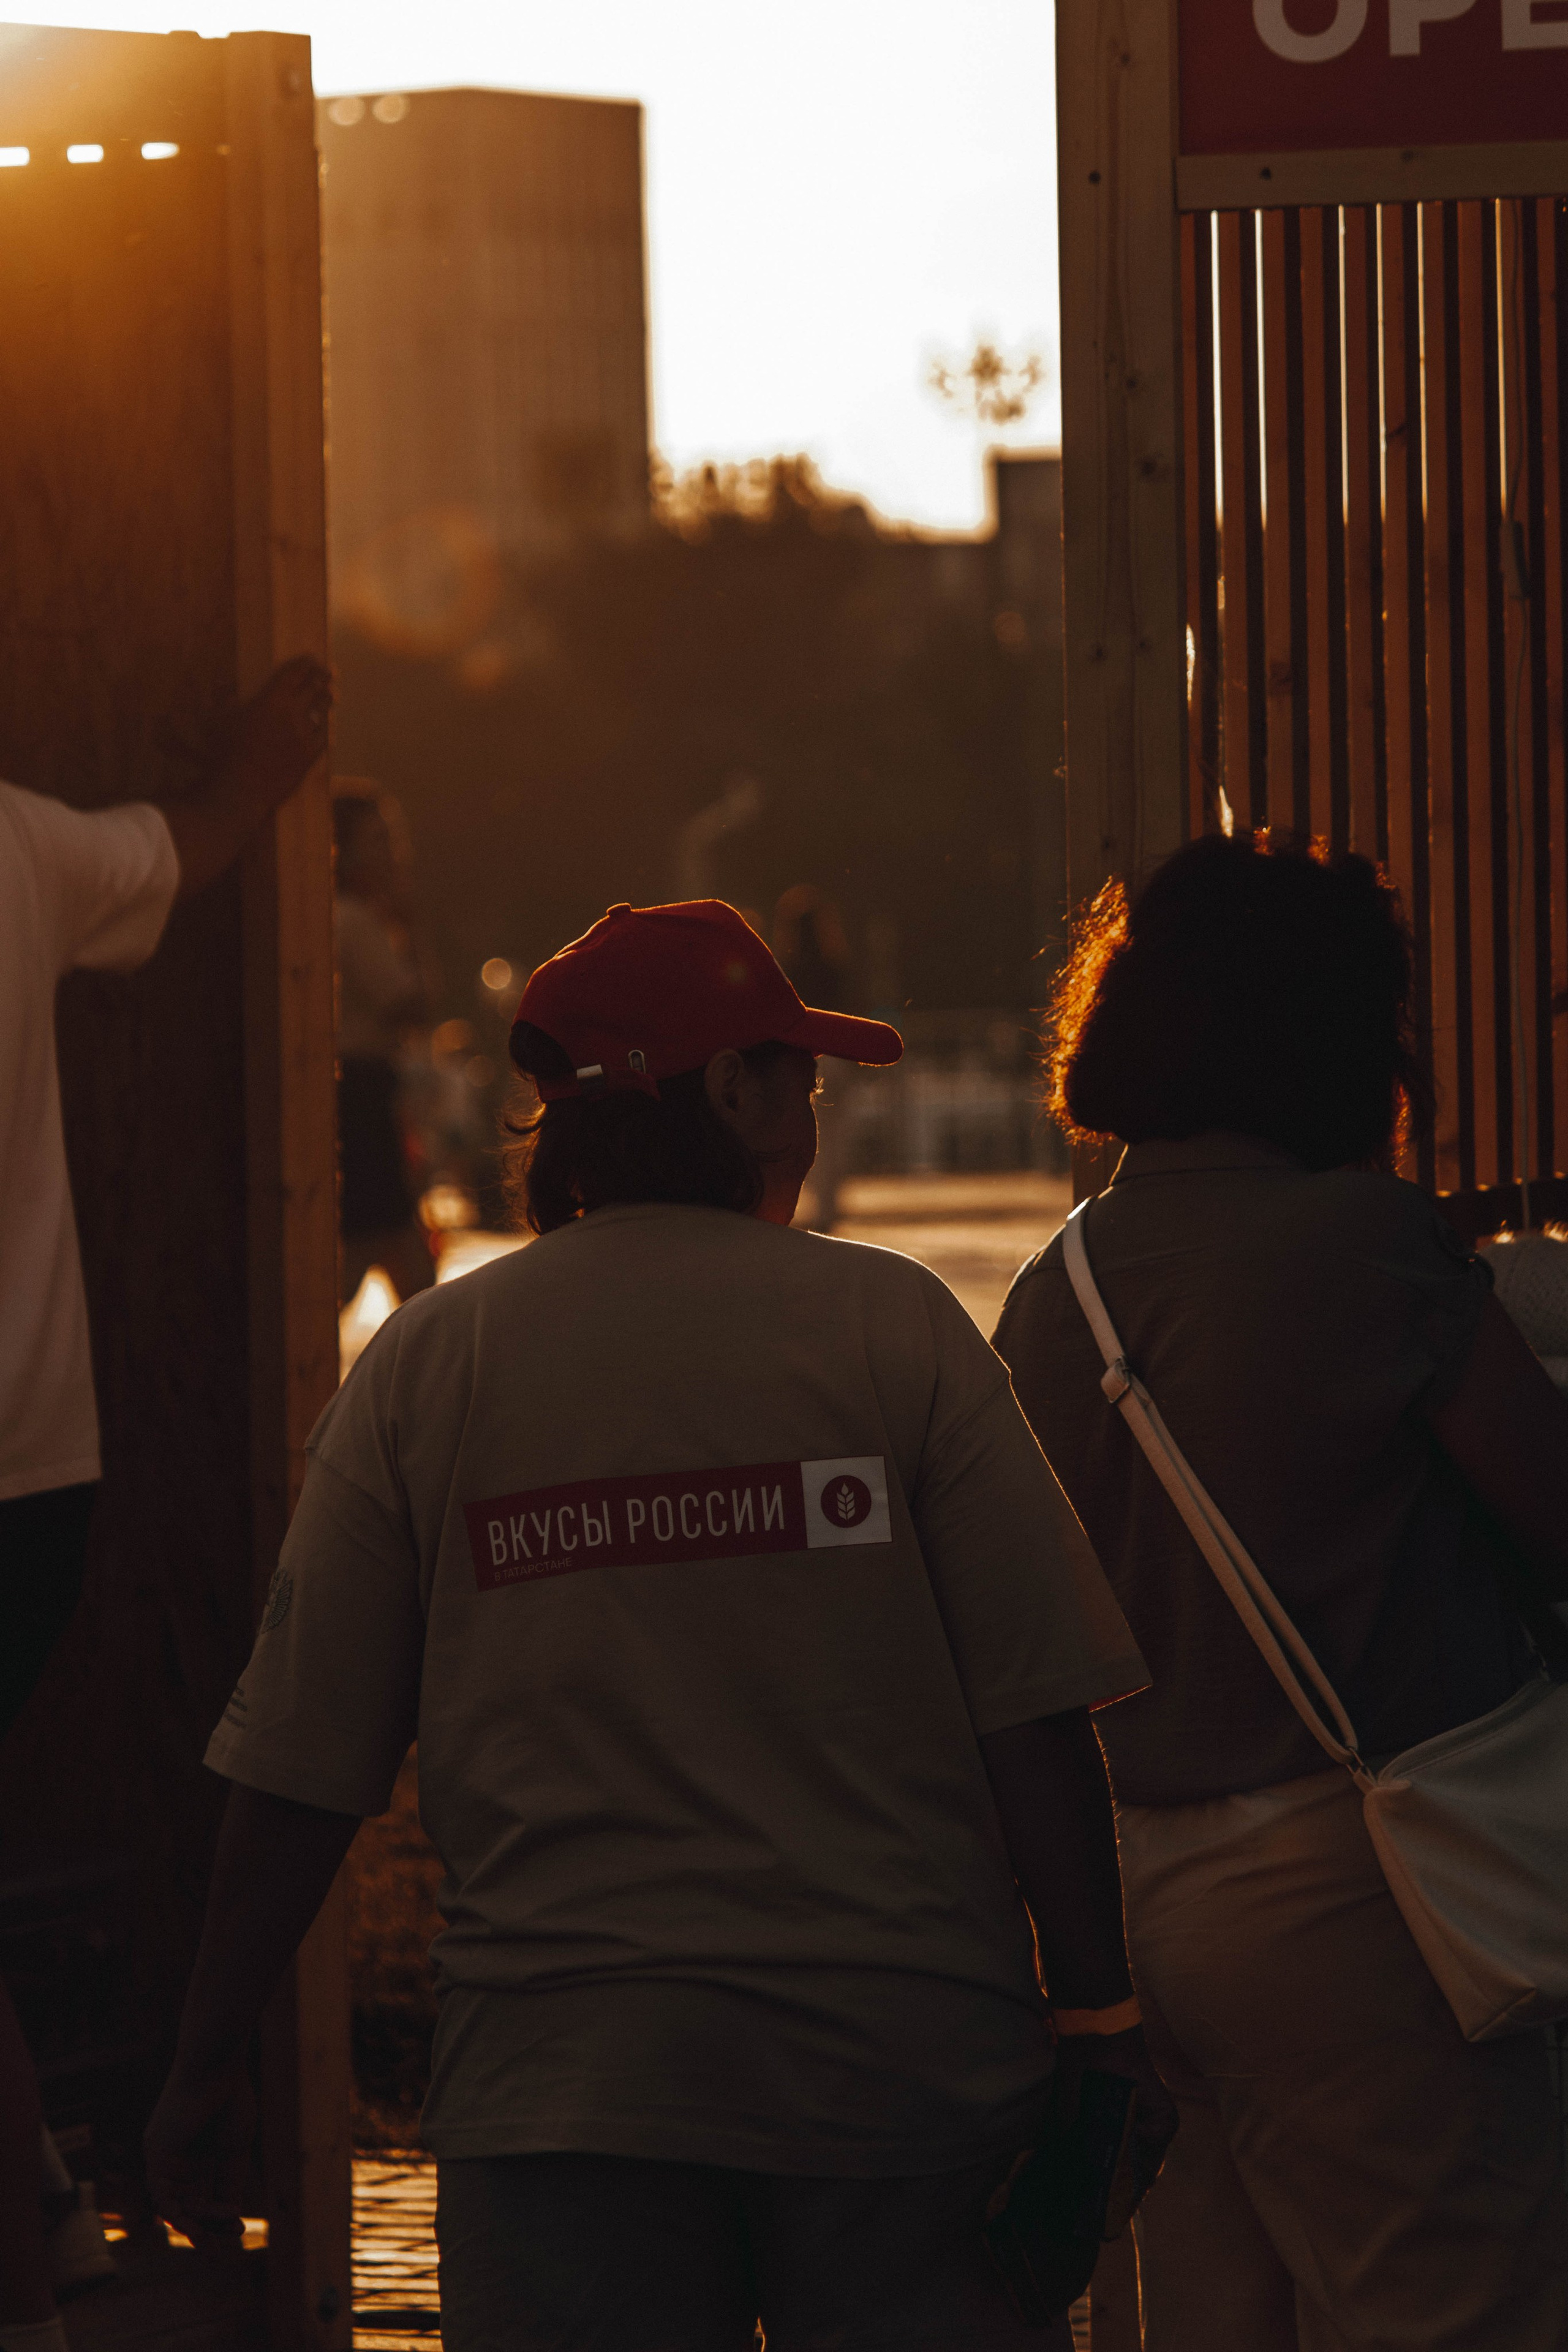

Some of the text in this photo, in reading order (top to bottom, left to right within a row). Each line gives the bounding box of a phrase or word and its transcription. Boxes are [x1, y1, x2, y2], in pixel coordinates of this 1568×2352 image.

[488, 1485, 786, 1566] ВКУСЫ РОССИИ
[503, 1557, 573, 1578] ТАТАРСТАНЕ
